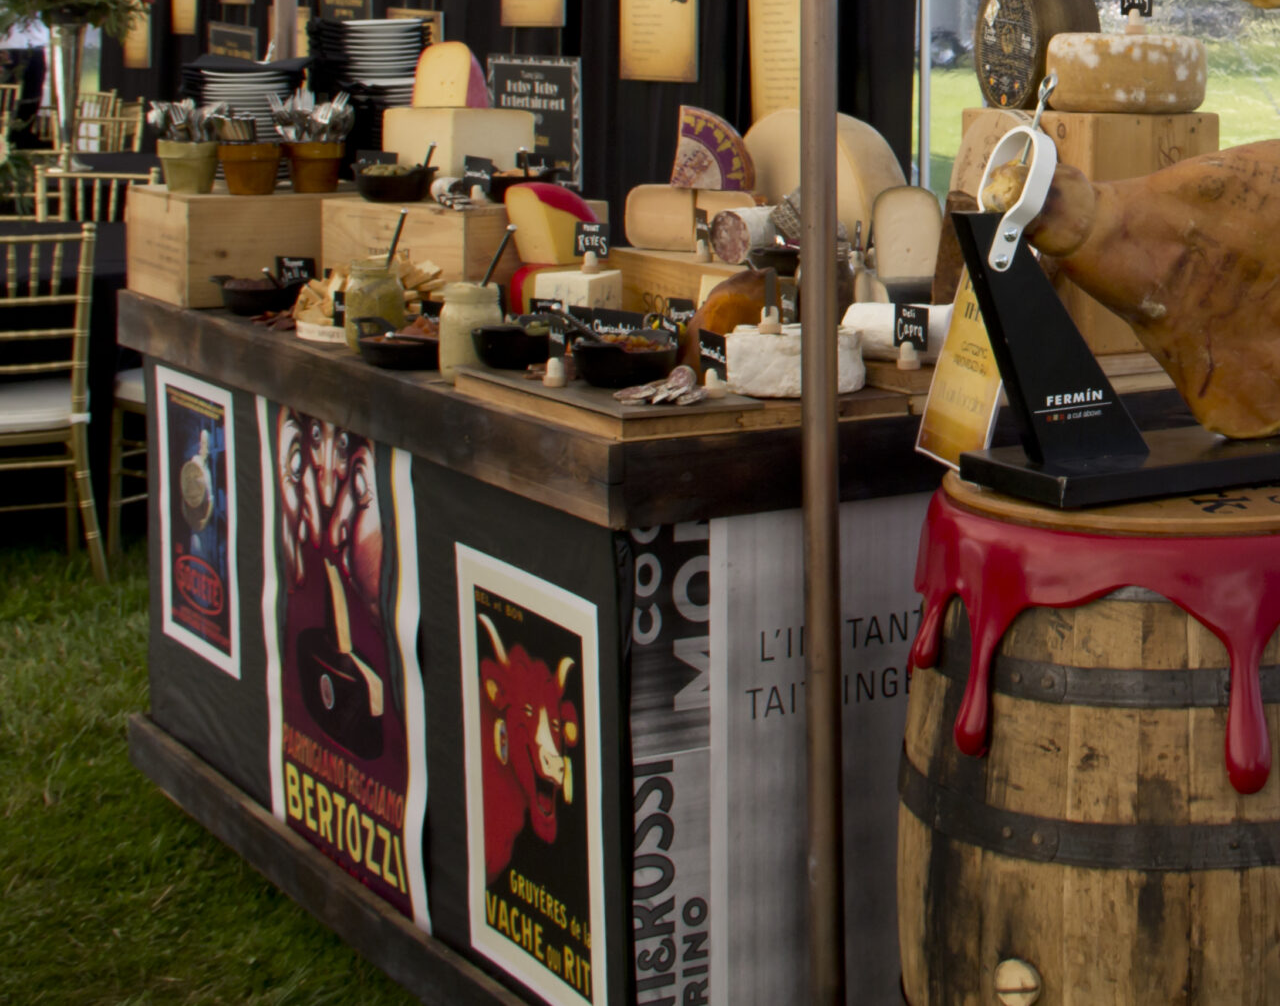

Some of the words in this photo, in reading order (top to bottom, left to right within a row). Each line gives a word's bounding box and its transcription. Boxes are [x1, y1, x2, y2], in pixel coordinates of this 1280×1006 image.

[577, 234, 609, 256] REYES
[897, 317, 924, 342] Capra
[1046, 388, 1103, 407] FERMÍN
[285, 762, 408, 895] BERTOZZI
[485, 891, 545, 962] VACHE
[563, 945, 592, 997] RIT
